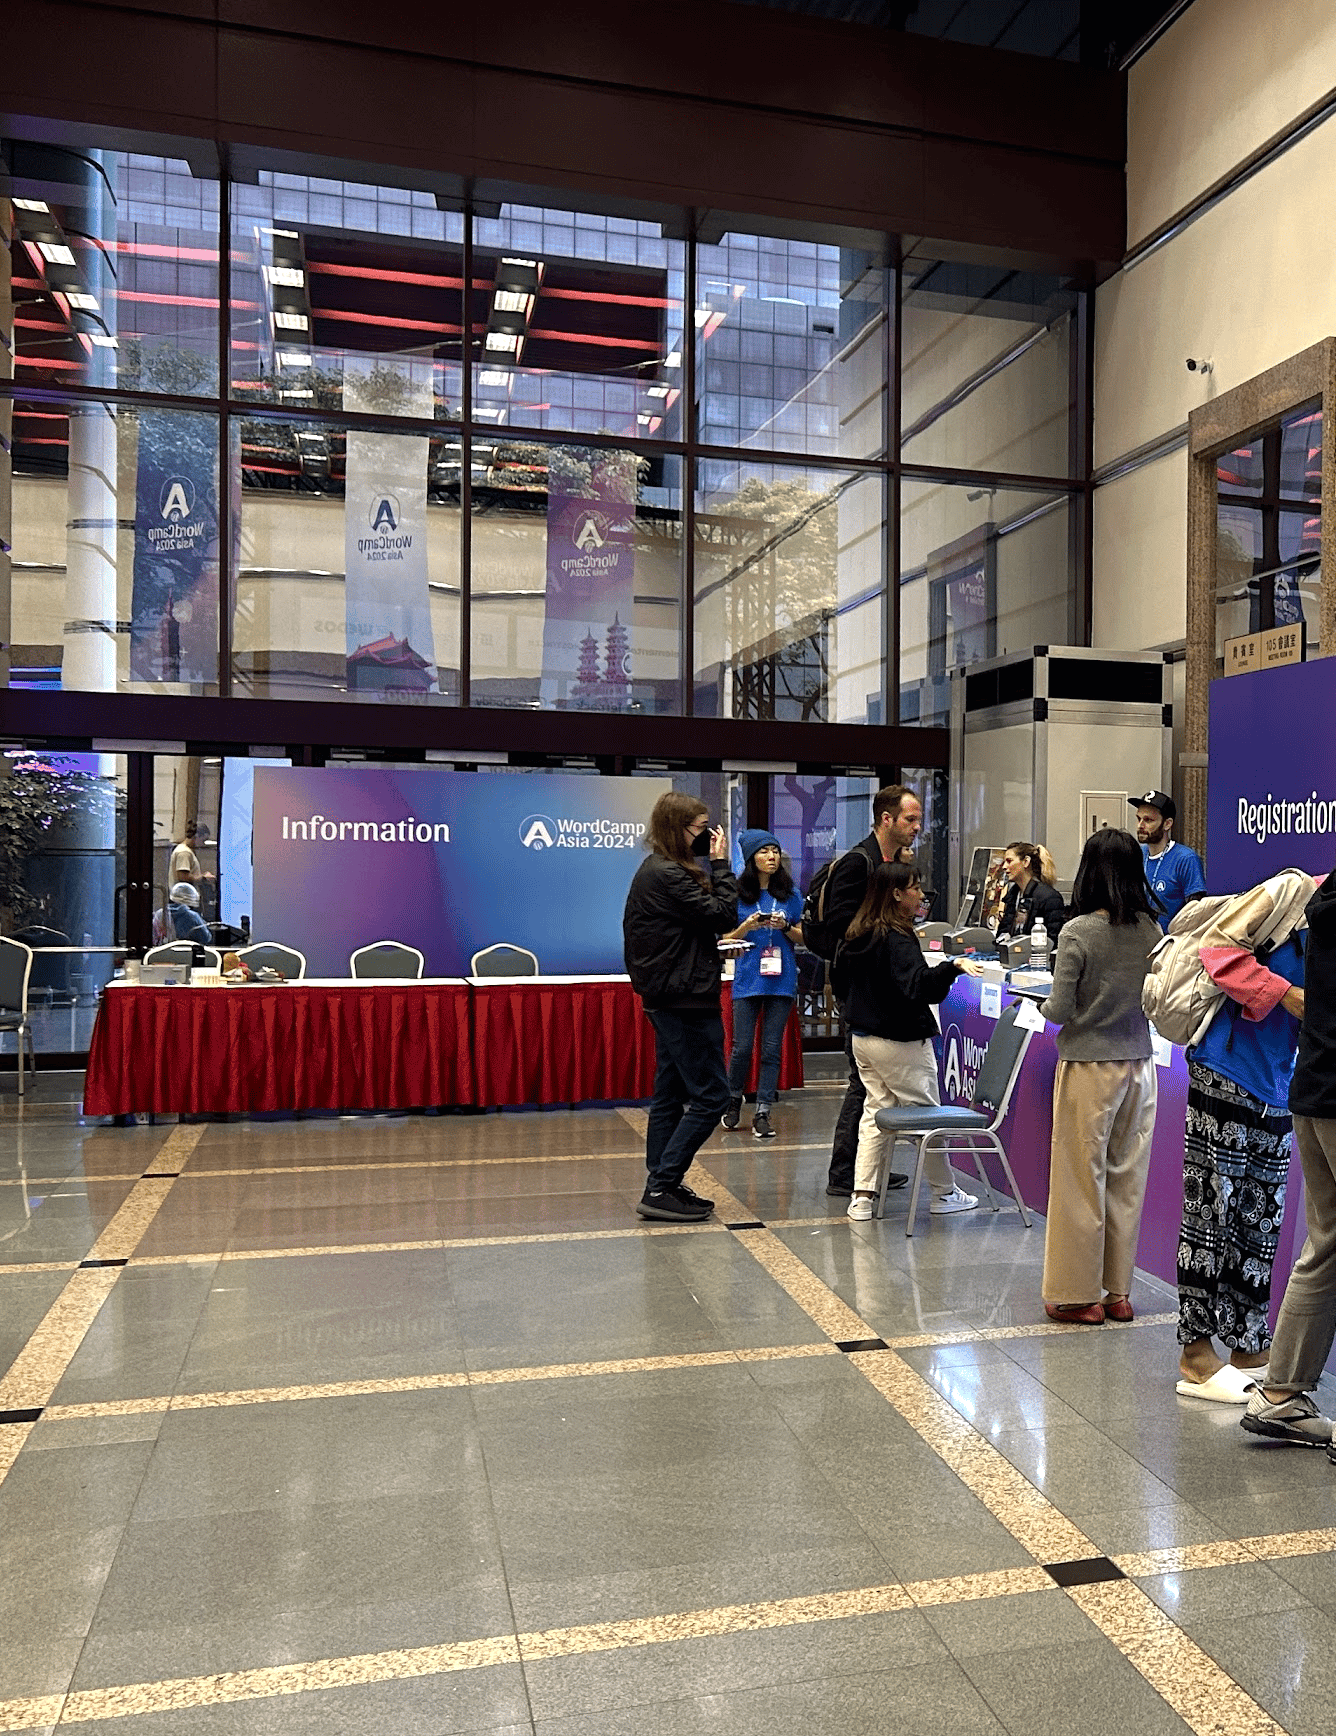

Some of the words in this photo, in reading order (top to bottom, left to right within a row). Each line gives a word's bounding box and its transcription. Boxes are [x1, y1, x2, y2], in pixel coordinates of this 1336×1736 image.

[281, 815, 450, 843] Information
[557, 818, 645, 839] WordCamp
[556, 834, 589, 848] Asia
[592, 834, 635, 849] 2024
